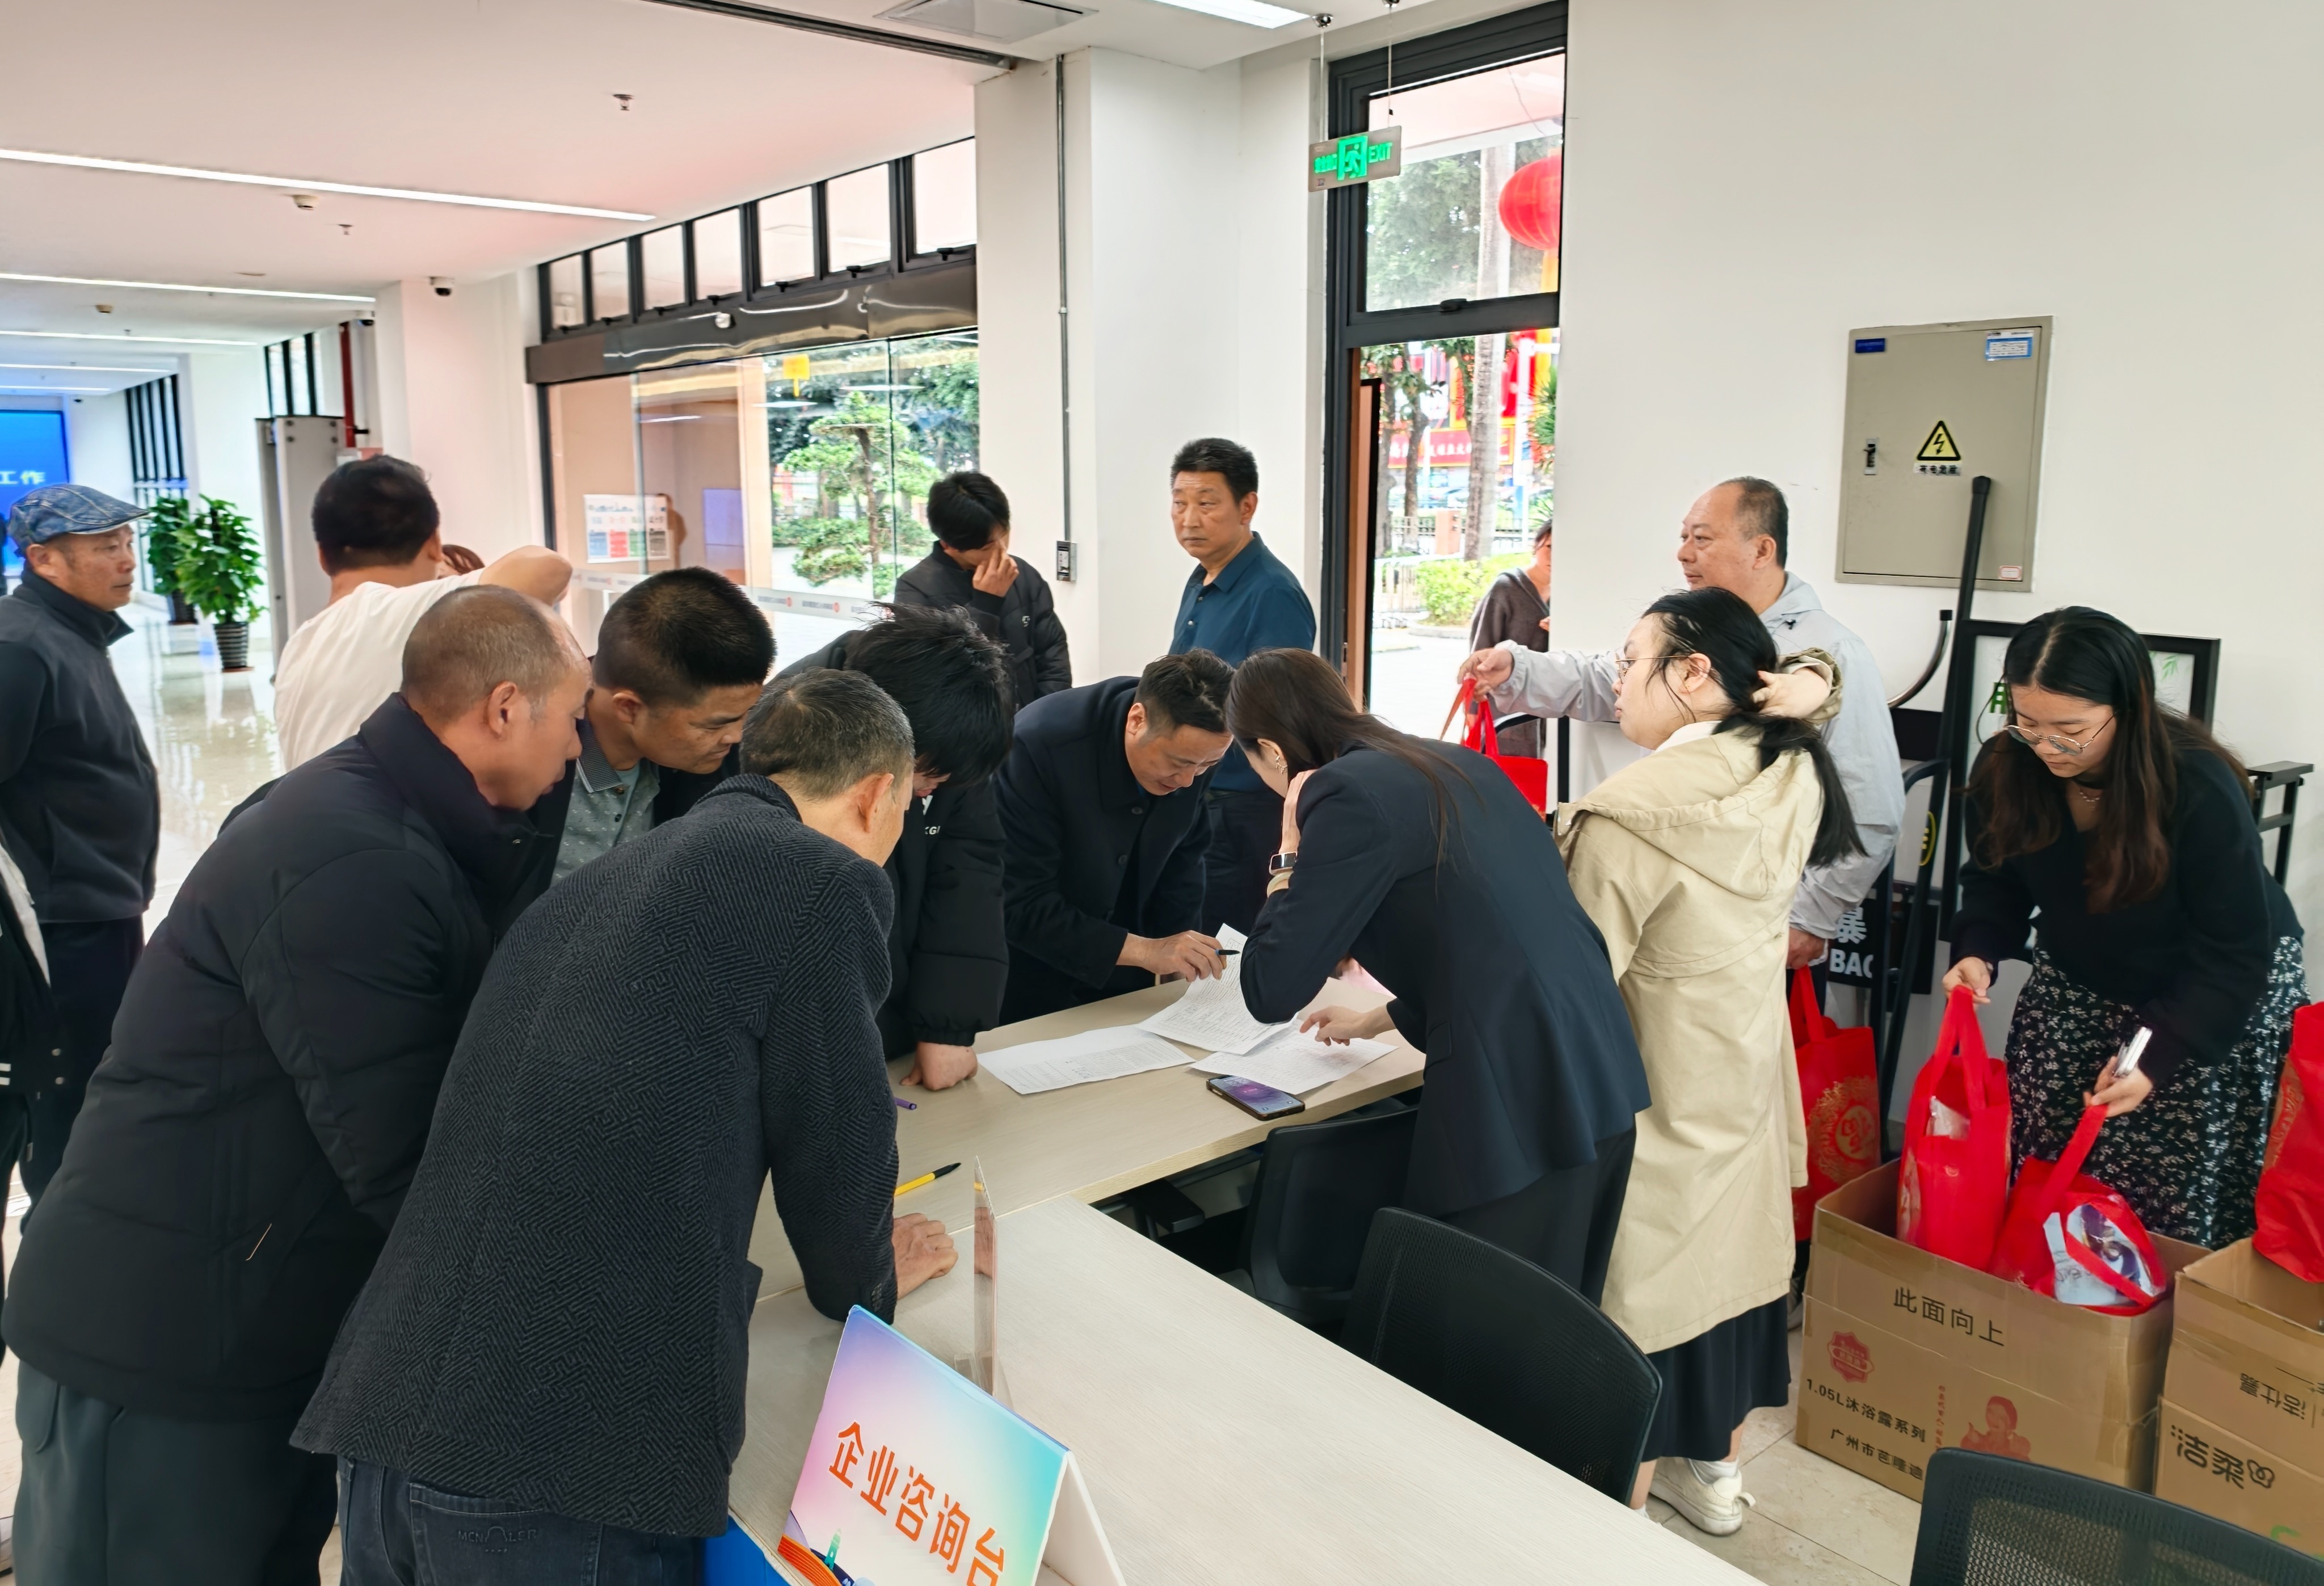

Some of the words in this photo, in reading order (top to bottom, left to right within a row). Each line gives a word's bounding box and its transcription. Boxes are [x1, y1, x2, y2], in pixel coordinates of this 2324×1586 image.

[1369, 142, 1393, 163] EXIT
[0, 470, 45, 485] 工作
[1893, 1287, 2004, 1347] 此面向上
[1807, 1378, 1925, 1442] 1.05L沐浴露系列
[2171, 1425, 2244, 1490] 洁柔
[829, 1421, 1004, 1586] 企业咨询台
